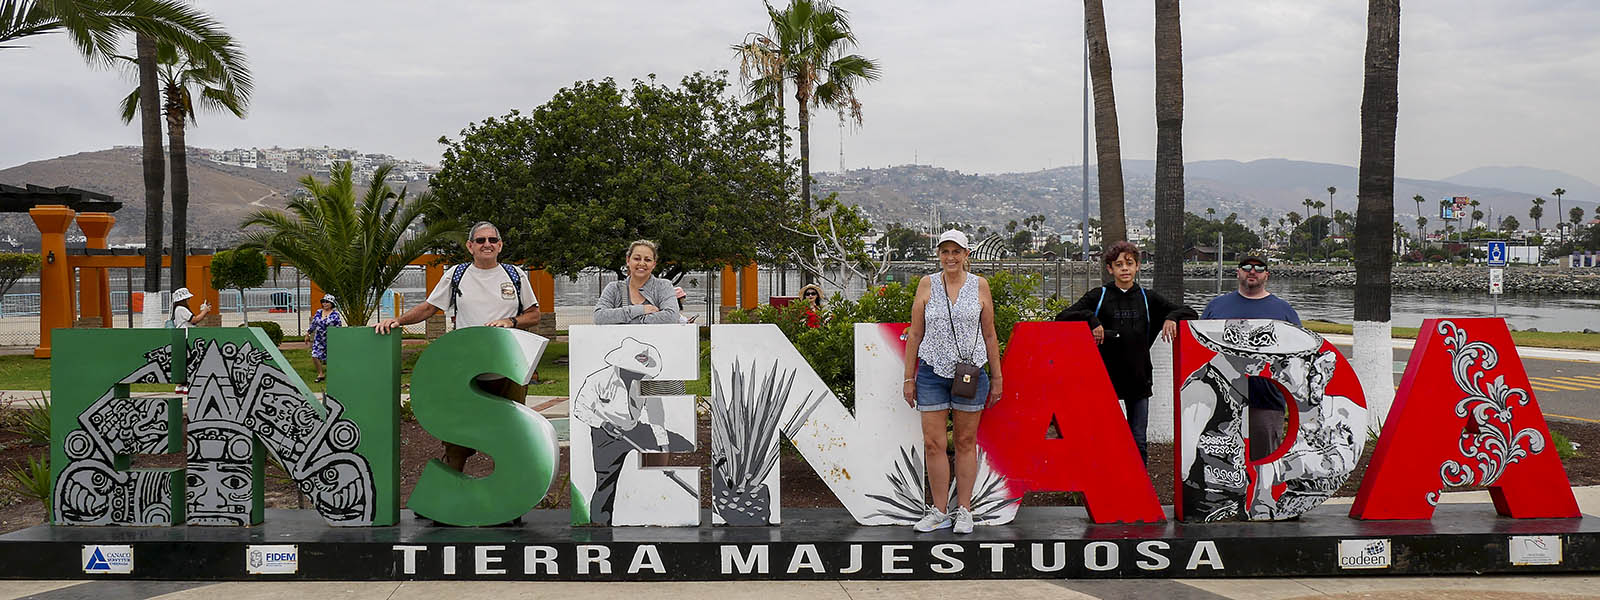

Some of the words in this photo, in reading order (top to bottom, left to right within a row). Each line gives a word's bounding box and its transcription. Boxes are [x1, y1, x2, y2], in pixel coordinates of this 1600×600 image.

[51, 318, 1581, 527] ENSENADA
[266, 553, 296, 561] FIDEM
[393, 545, 667, 574] TIERRA
[721, 541, 1225, 574] MAJESTUOSA
[1341, 550, 1386, 565] codeen
